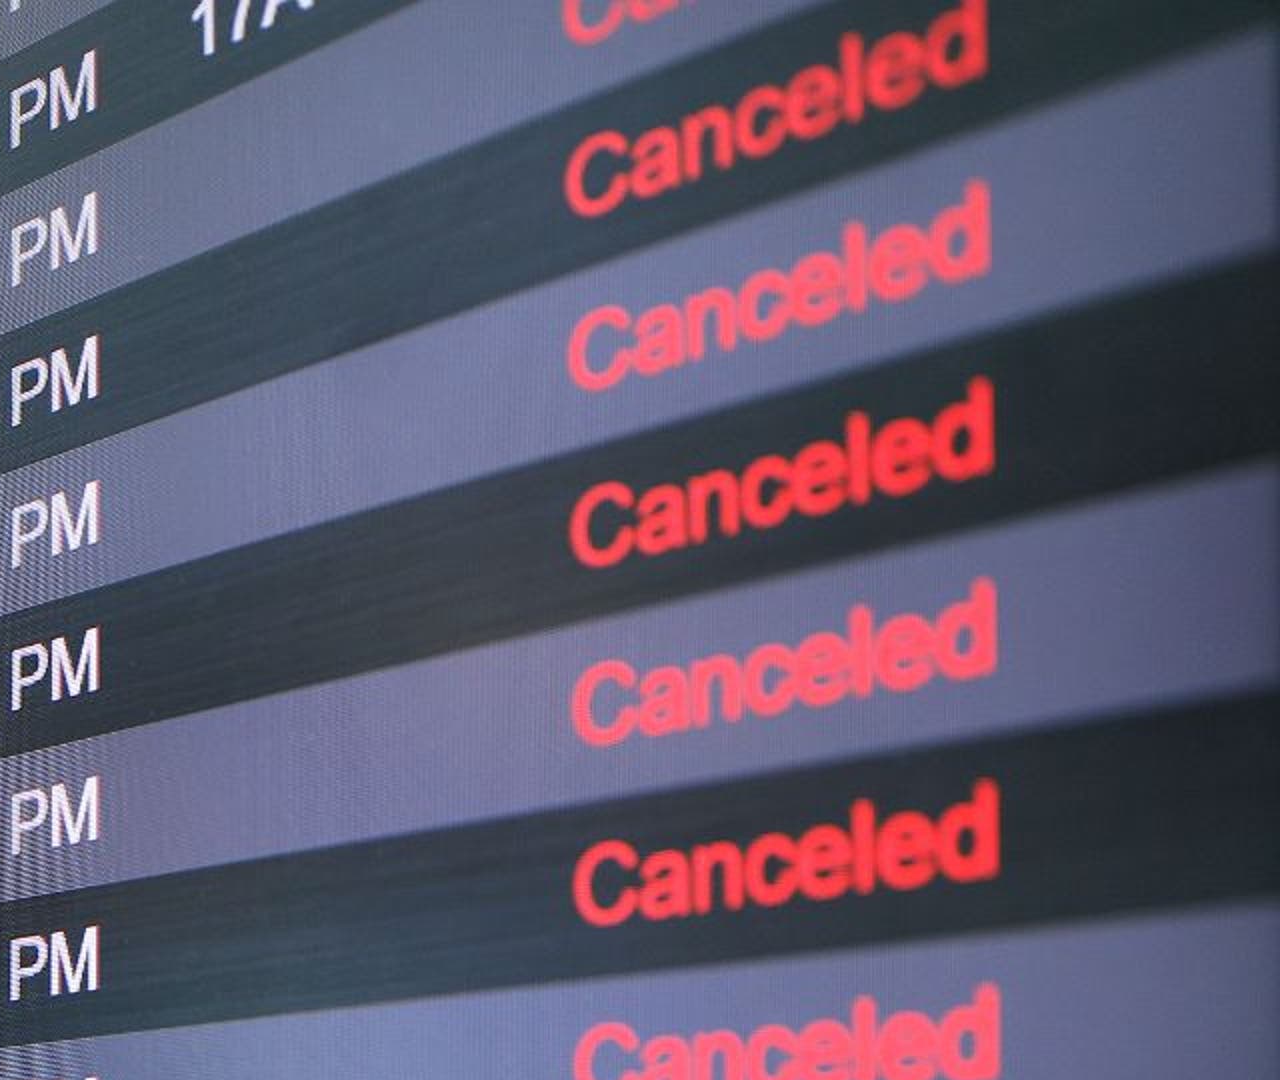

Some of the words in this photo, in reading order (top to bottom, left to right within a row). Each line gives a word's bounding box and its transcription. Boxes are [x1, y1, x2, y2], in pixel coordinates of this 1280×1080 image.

[8, 49, 98, 150] PM
[9, 334, 100, 428] PM
[565, 0, 988, 217] Canceled
[9, 191, 99, 288] PM
[10, 480, 101, 569] PM
[568, 182, 991, 391] Canceled
[10, 626, 101, 712] PM
[568, 376, 996, 568] Canceled
[10, 774, 100, 856] PM
[571, 578, 997, 746] Canceled
[9, 924, 100, 1002] PM
[572, 777, 1002, 927] Canceled
